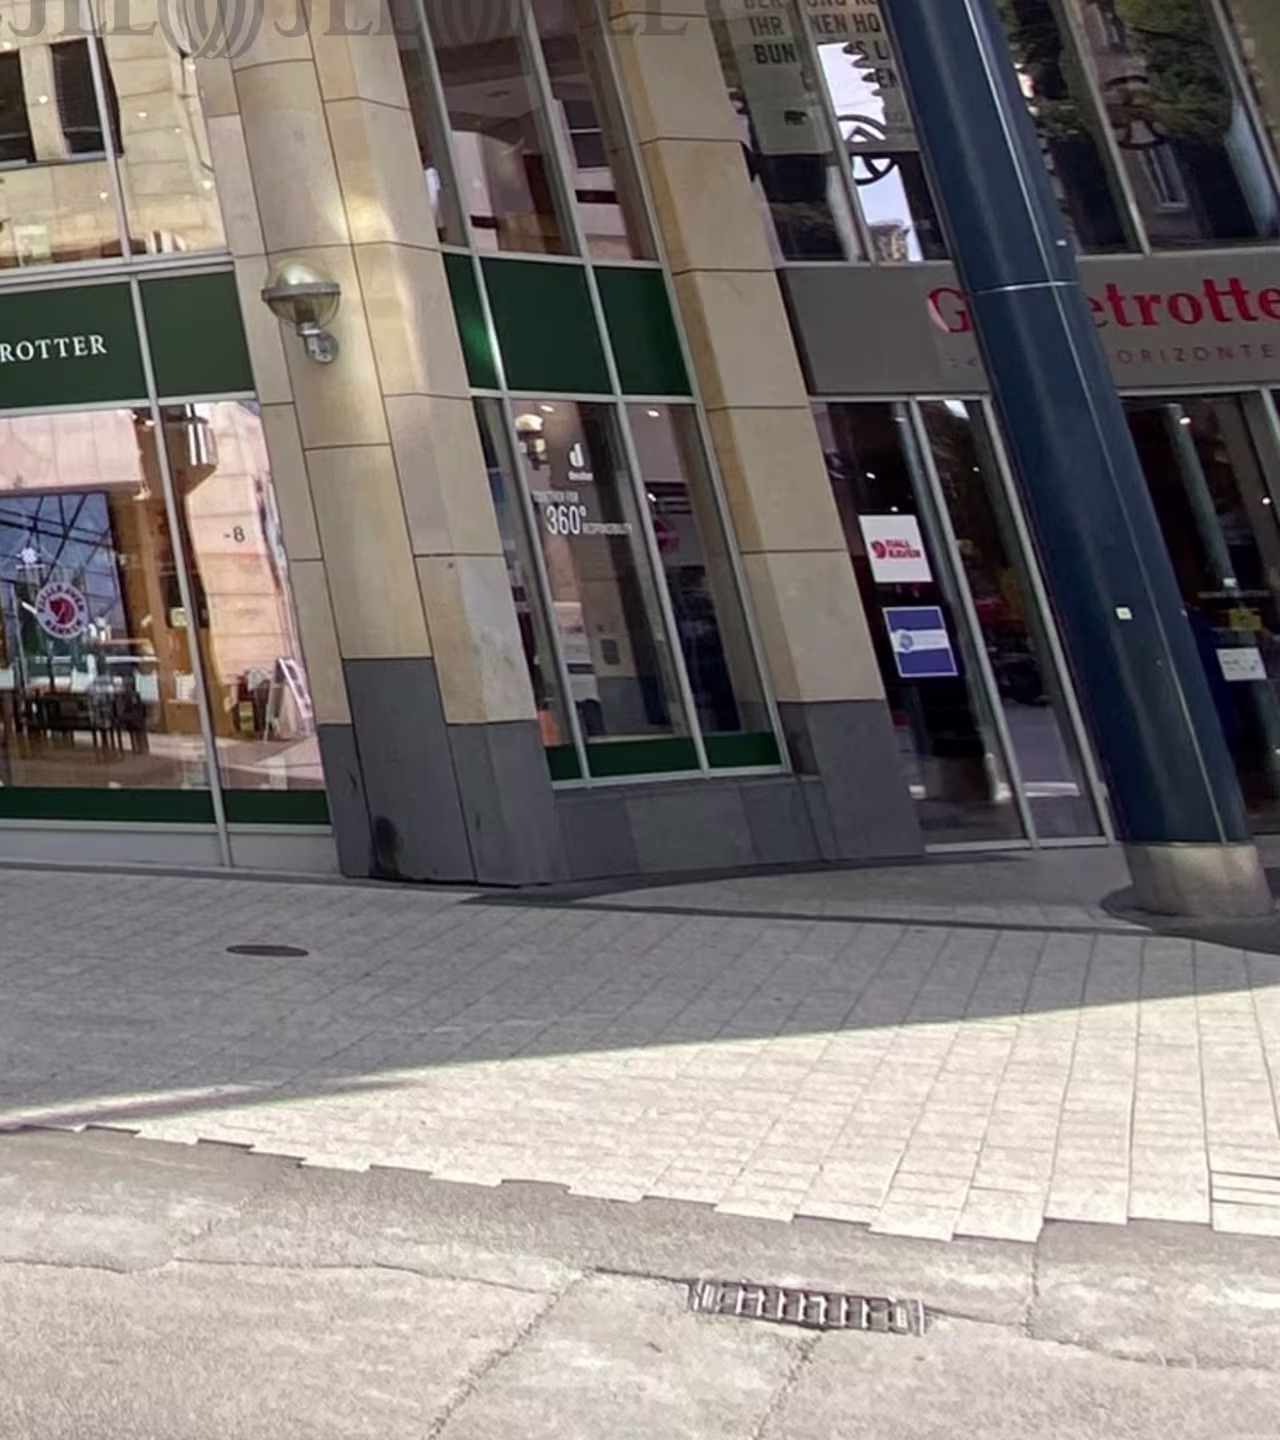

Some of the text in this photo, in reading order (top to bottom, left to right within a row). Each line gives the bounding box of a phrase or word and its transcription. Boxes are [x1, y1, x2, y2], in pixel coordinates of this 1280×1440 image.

[754, 43, 796, 64] BUN
[928, 276, 1280, 334] Getrotte
[1115, 341, 1278, 366] ORIZONTE
